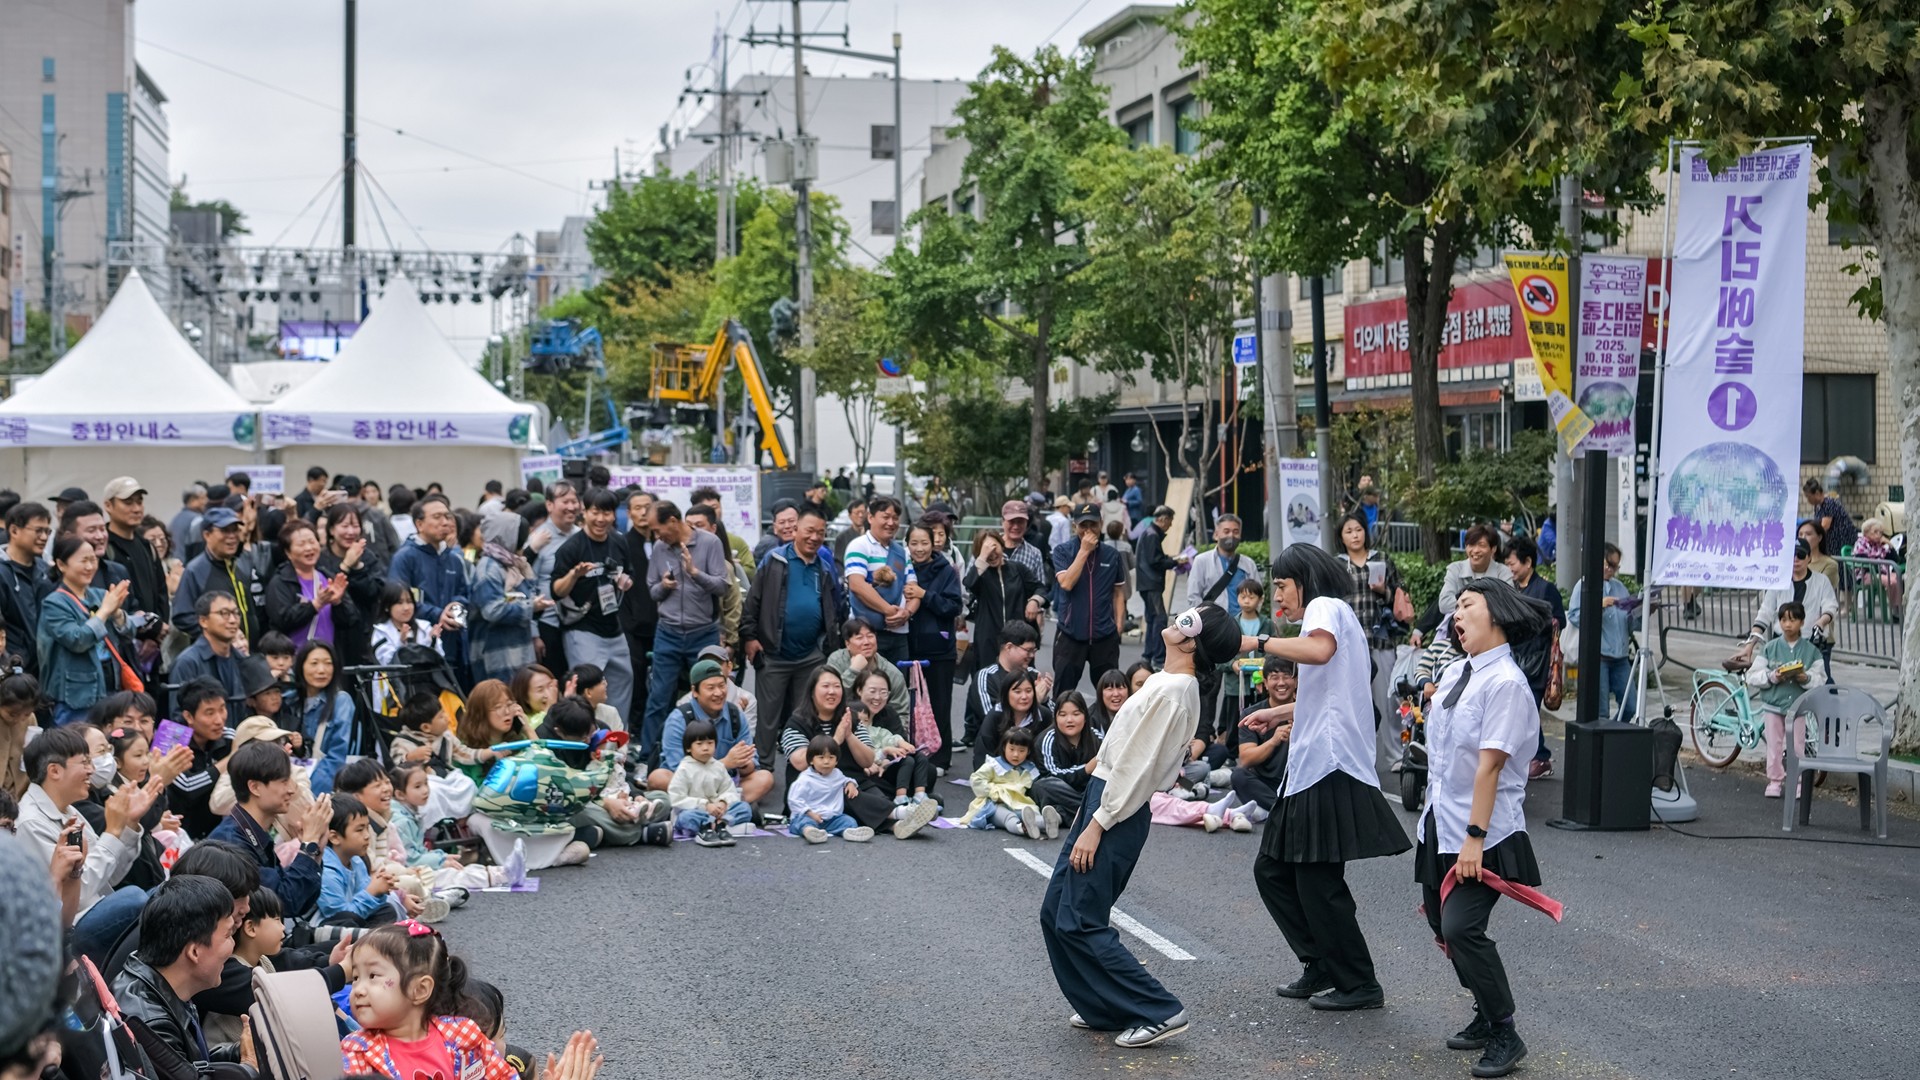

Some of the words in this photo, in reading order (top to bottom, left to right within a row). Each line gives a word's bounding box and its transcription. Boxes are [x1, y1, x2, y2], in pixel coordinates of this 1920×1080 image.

[1582, 301, 1643, 321] 동대문
[1465, 320, 1512, 342] 2244-9342
[1581, 322, 1641, 338] 페스티벌
[1353, 323, 1385, 356] 디오씨
[1595, 339, 1627, 351] 2025.
[1618, 366, 1637, 378] 일대
[71, 421, 182, 441] 종합안내소
[352, 419, 460, 441] 종합안내소
[1281, 462, 1318, 472] 동대문페스티
[646, 475, 692, 487] 페스티벌
